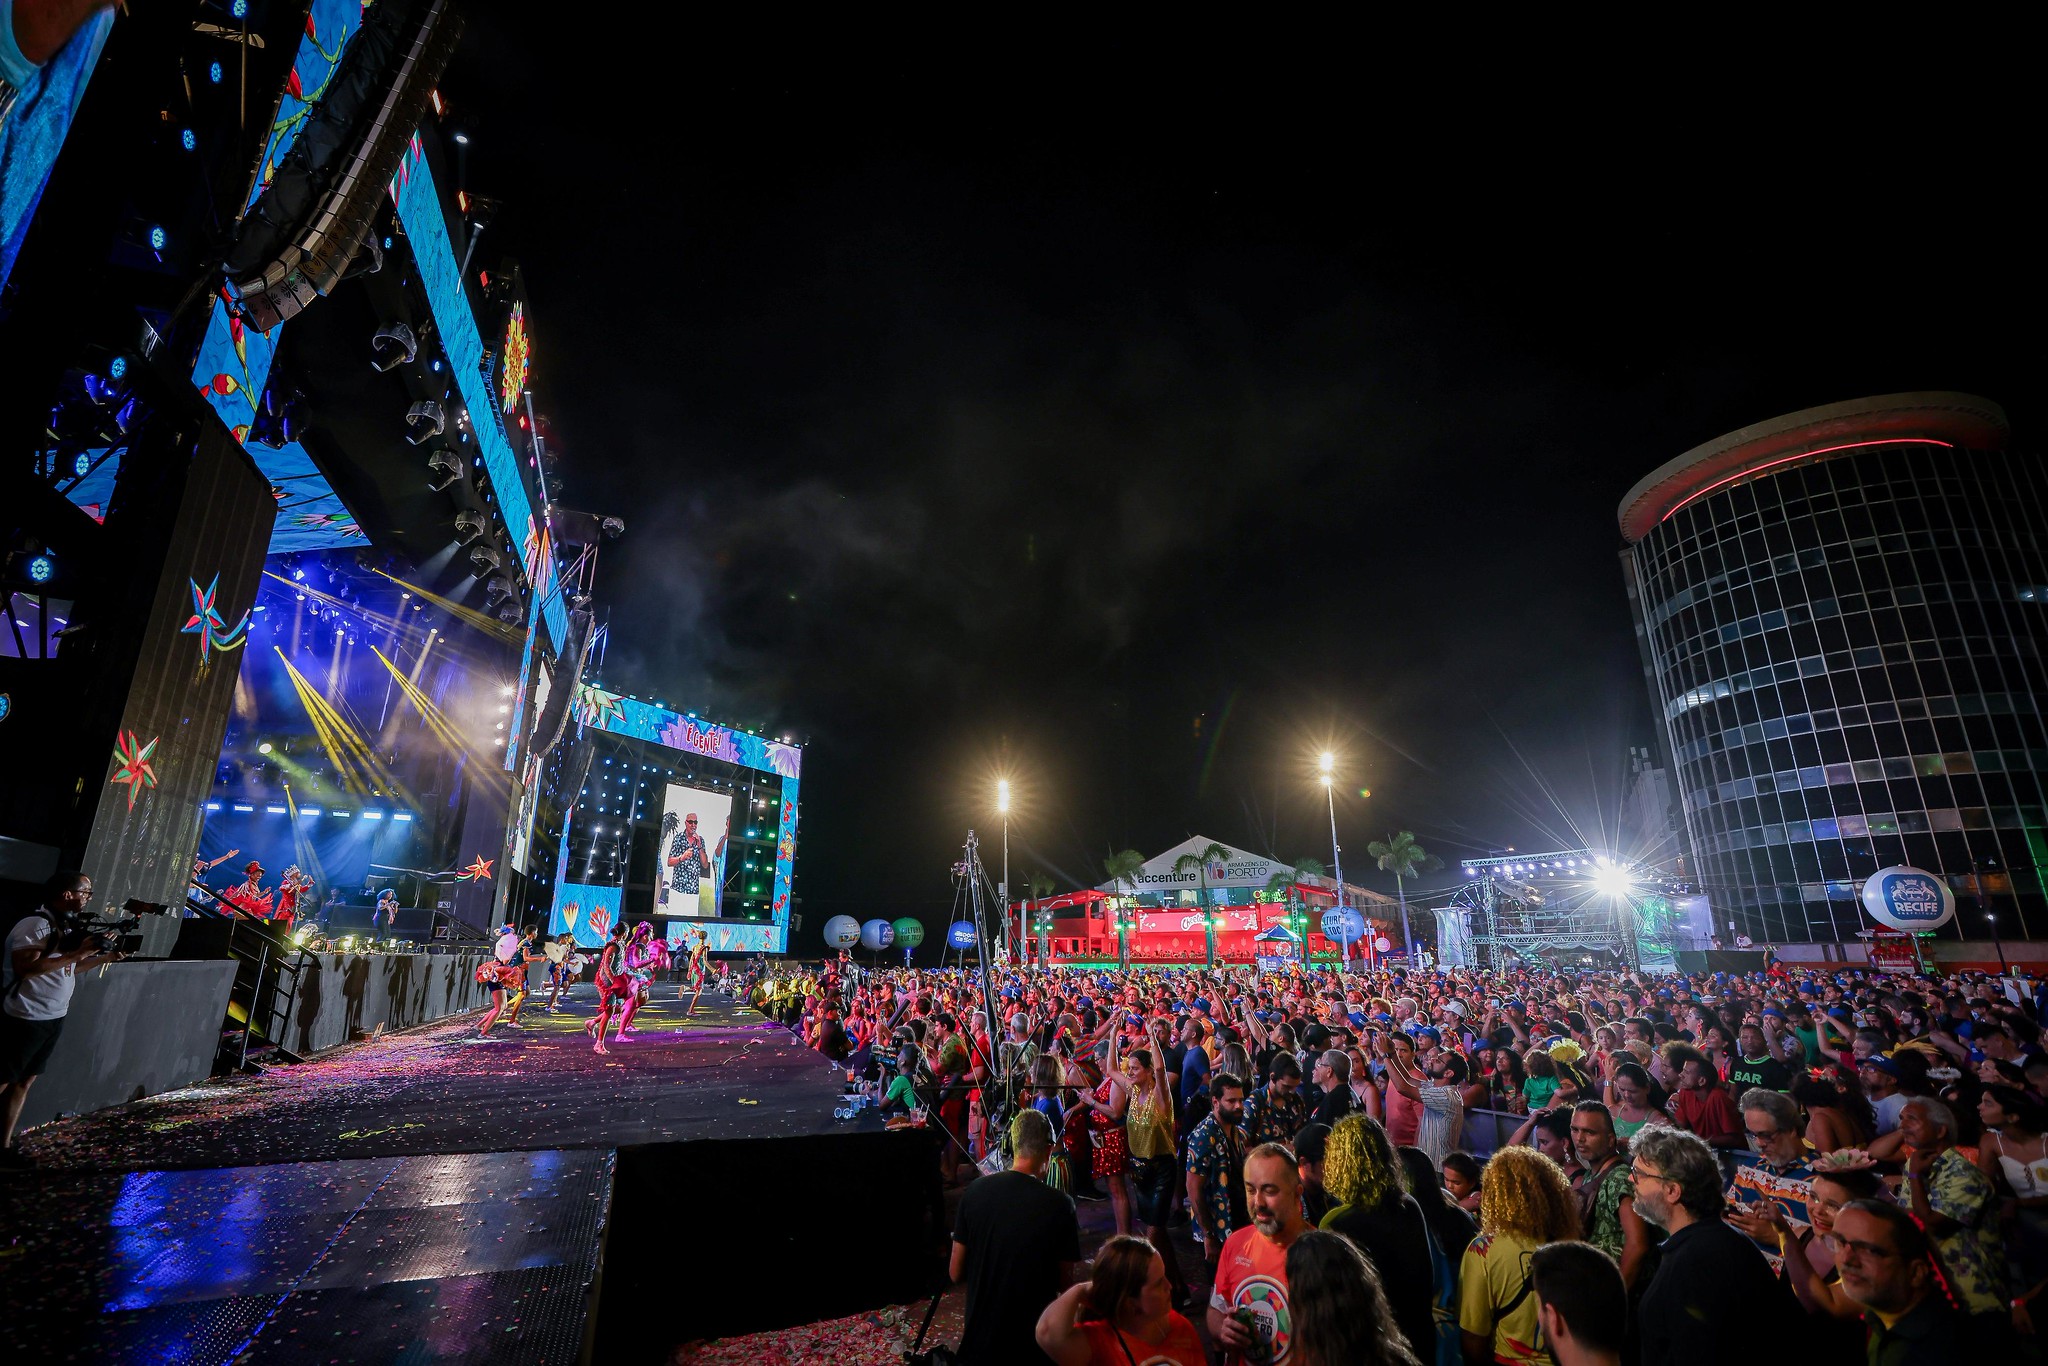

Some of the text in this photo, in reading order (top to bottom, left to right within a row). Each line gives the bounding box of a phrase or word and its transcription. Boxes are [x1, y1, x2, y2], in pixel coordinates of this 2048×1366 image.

[687, 724, 722, 754] É GENTE!
[1227, 866, 1268, 877] PORTO
[1137, 872, 1197, 884] accenture
[1895, 902, 1938, 912] RECIFE
[1181, 912, 1206, 931] Cheeto
[1733, 1070, 1762, 1085] BAR
[1255, 1314, 1274, 1326] ARCO
